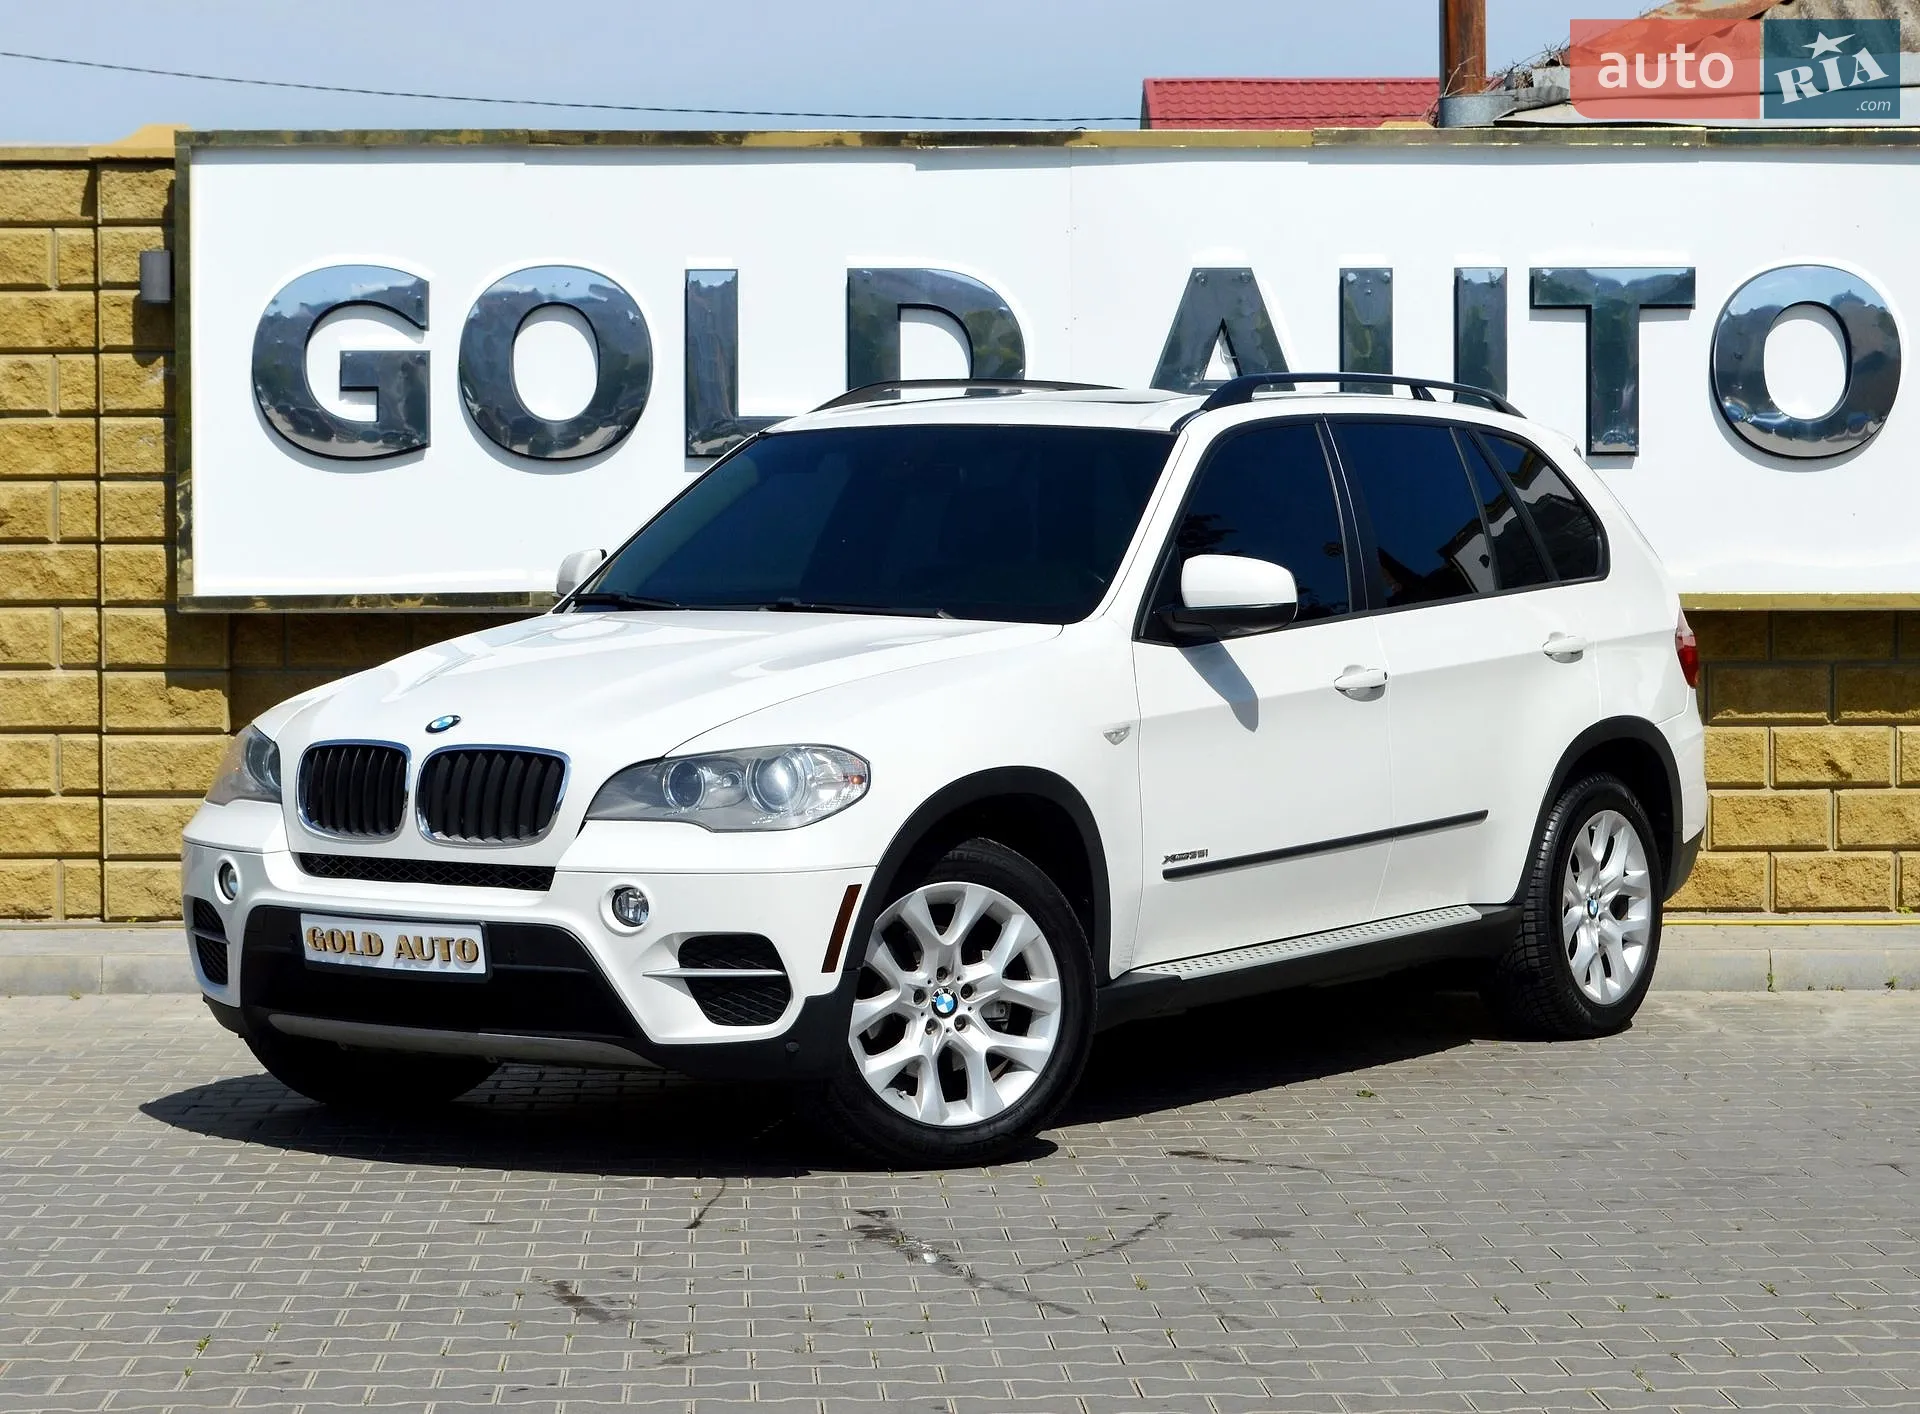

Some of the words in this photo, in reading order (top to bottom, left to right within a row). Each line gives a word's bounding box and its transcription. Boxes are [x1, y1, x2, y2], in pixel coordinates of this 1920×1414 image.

[251, 264, 1026, 461] GOLD
[1149, 264, 1902, 460] AUTO
[306, 926, 384, 957] GOLD
[395, 935, 480, 963] AUTO
